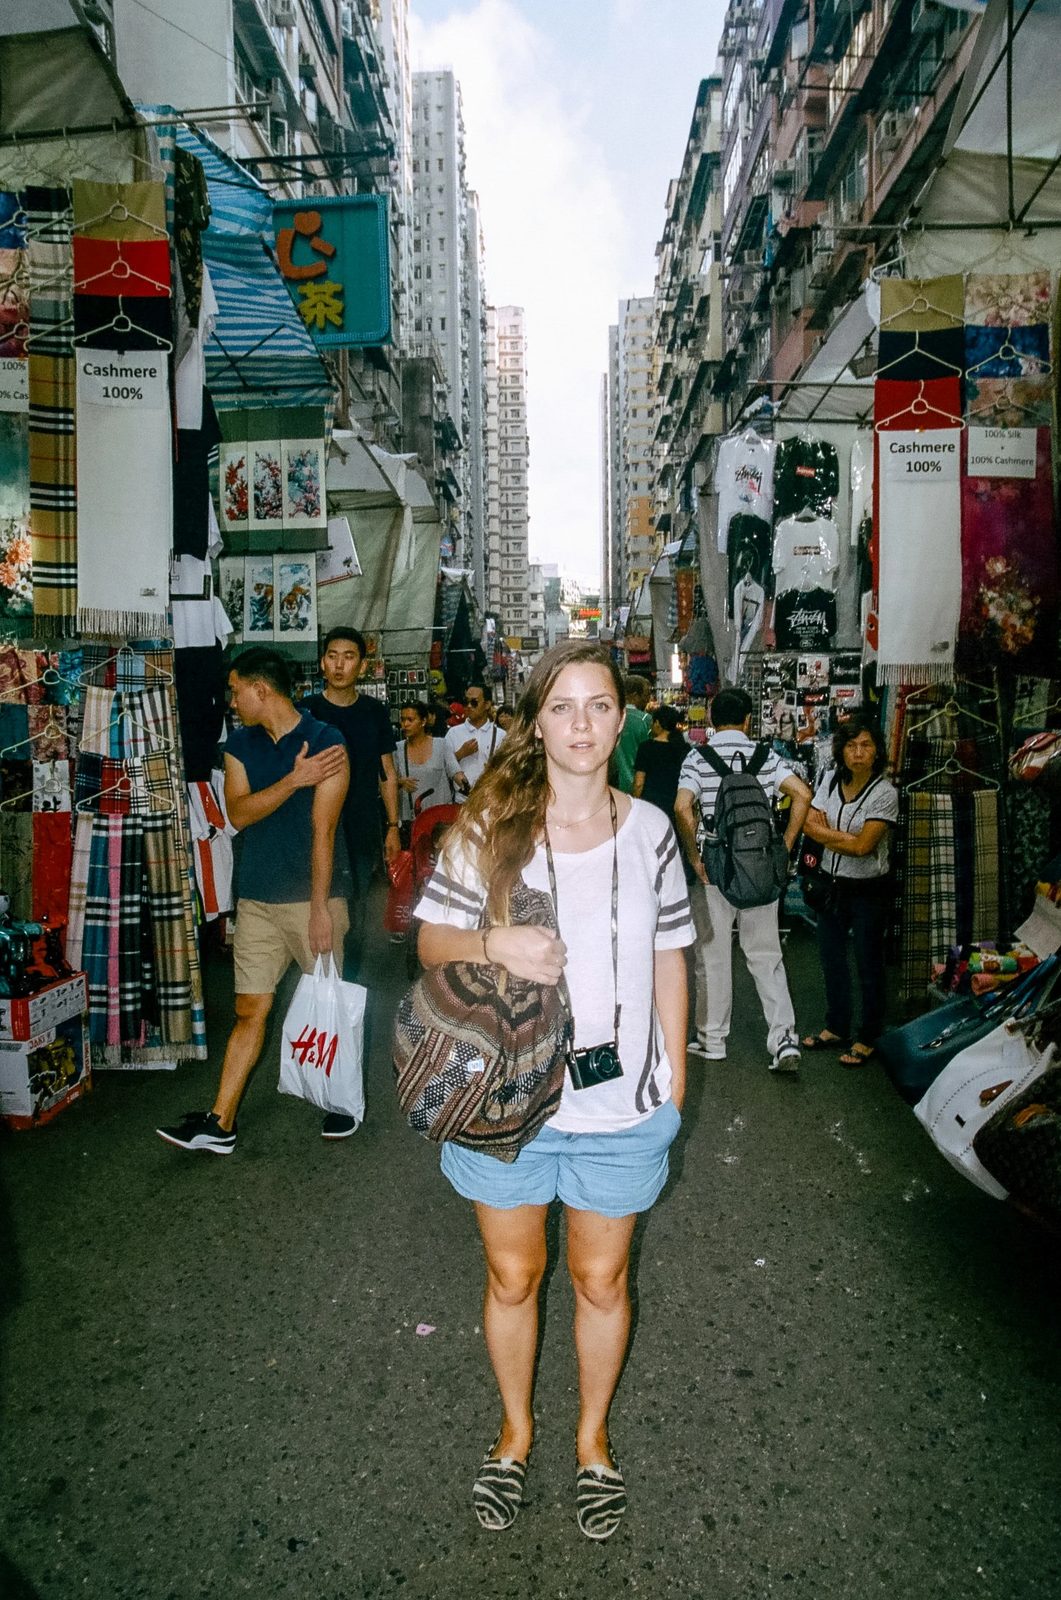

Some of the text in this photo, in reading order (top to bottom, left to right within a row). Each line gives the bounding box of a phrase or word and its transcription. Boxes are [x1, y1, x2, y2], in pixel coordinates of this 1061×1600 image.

[2, 361, 26, 370] 100%
[83, 362, 157, 378] Cashmere
[102, 386, 143, 400] 100%
[1007, 429, 1022, 439] Silk
[889, 441, 956, 454] Cashmere
[906, 460, 942, 473] 100%
[971, 456, 1034, 466] 100% Cashmere
[289, 1024, 339, 1078] H&M
